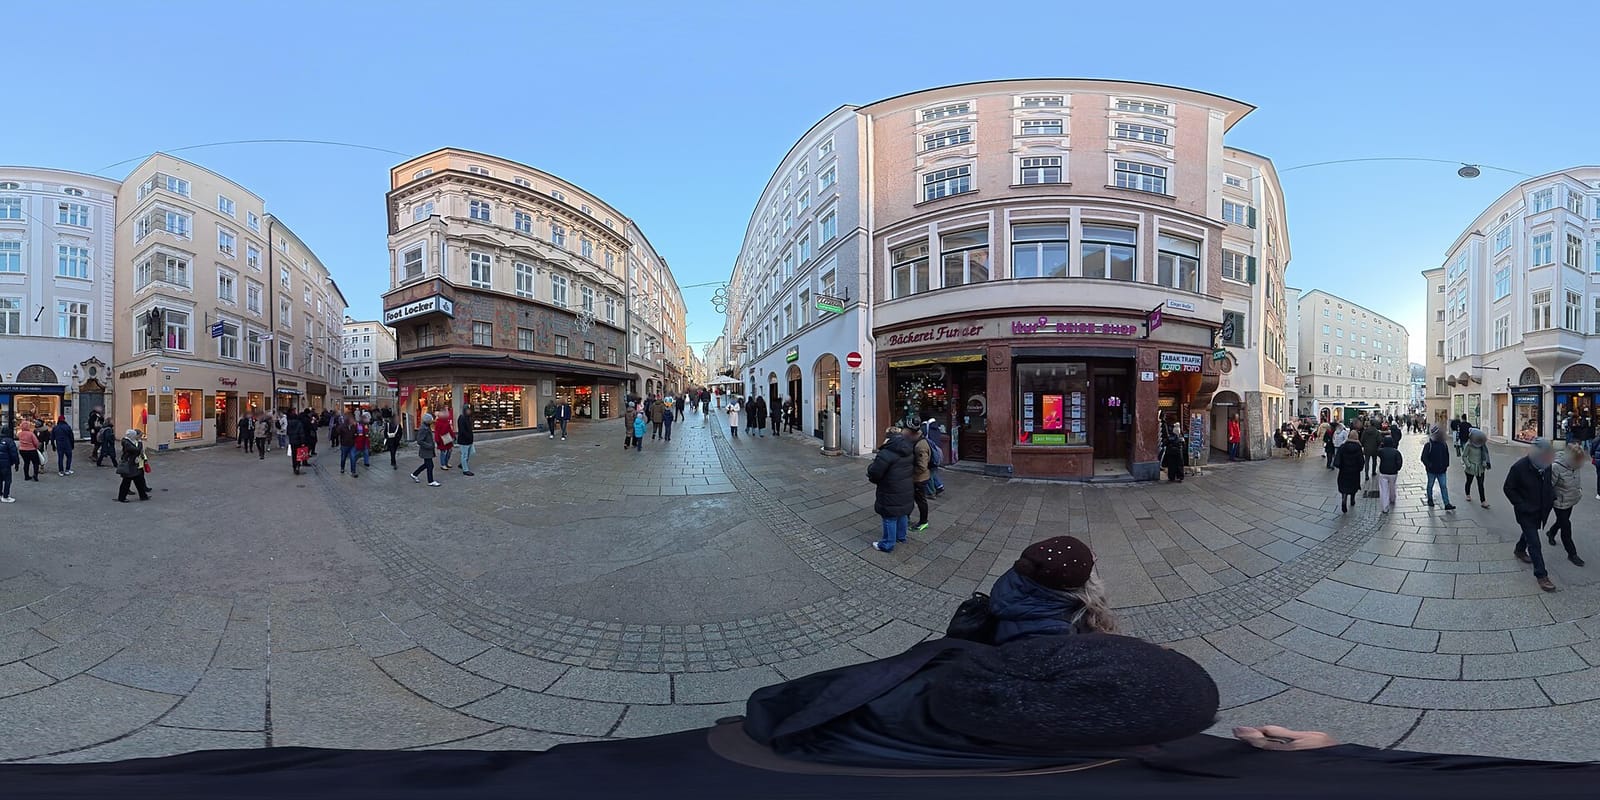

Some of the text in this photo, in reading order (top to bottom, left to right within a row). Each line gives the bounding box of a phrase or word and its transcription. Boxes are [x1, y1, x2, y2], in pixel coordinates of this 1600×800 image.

[386, 301, 434, 321] Foot Locker
[1102, 324, 1137, 335] SHOP
[889, 328, 935, 346] Bäckerei
[1162, 354, 1201, 364] TABAK TRAFIK
[1161, 363, 1181, 371] LOTTO
